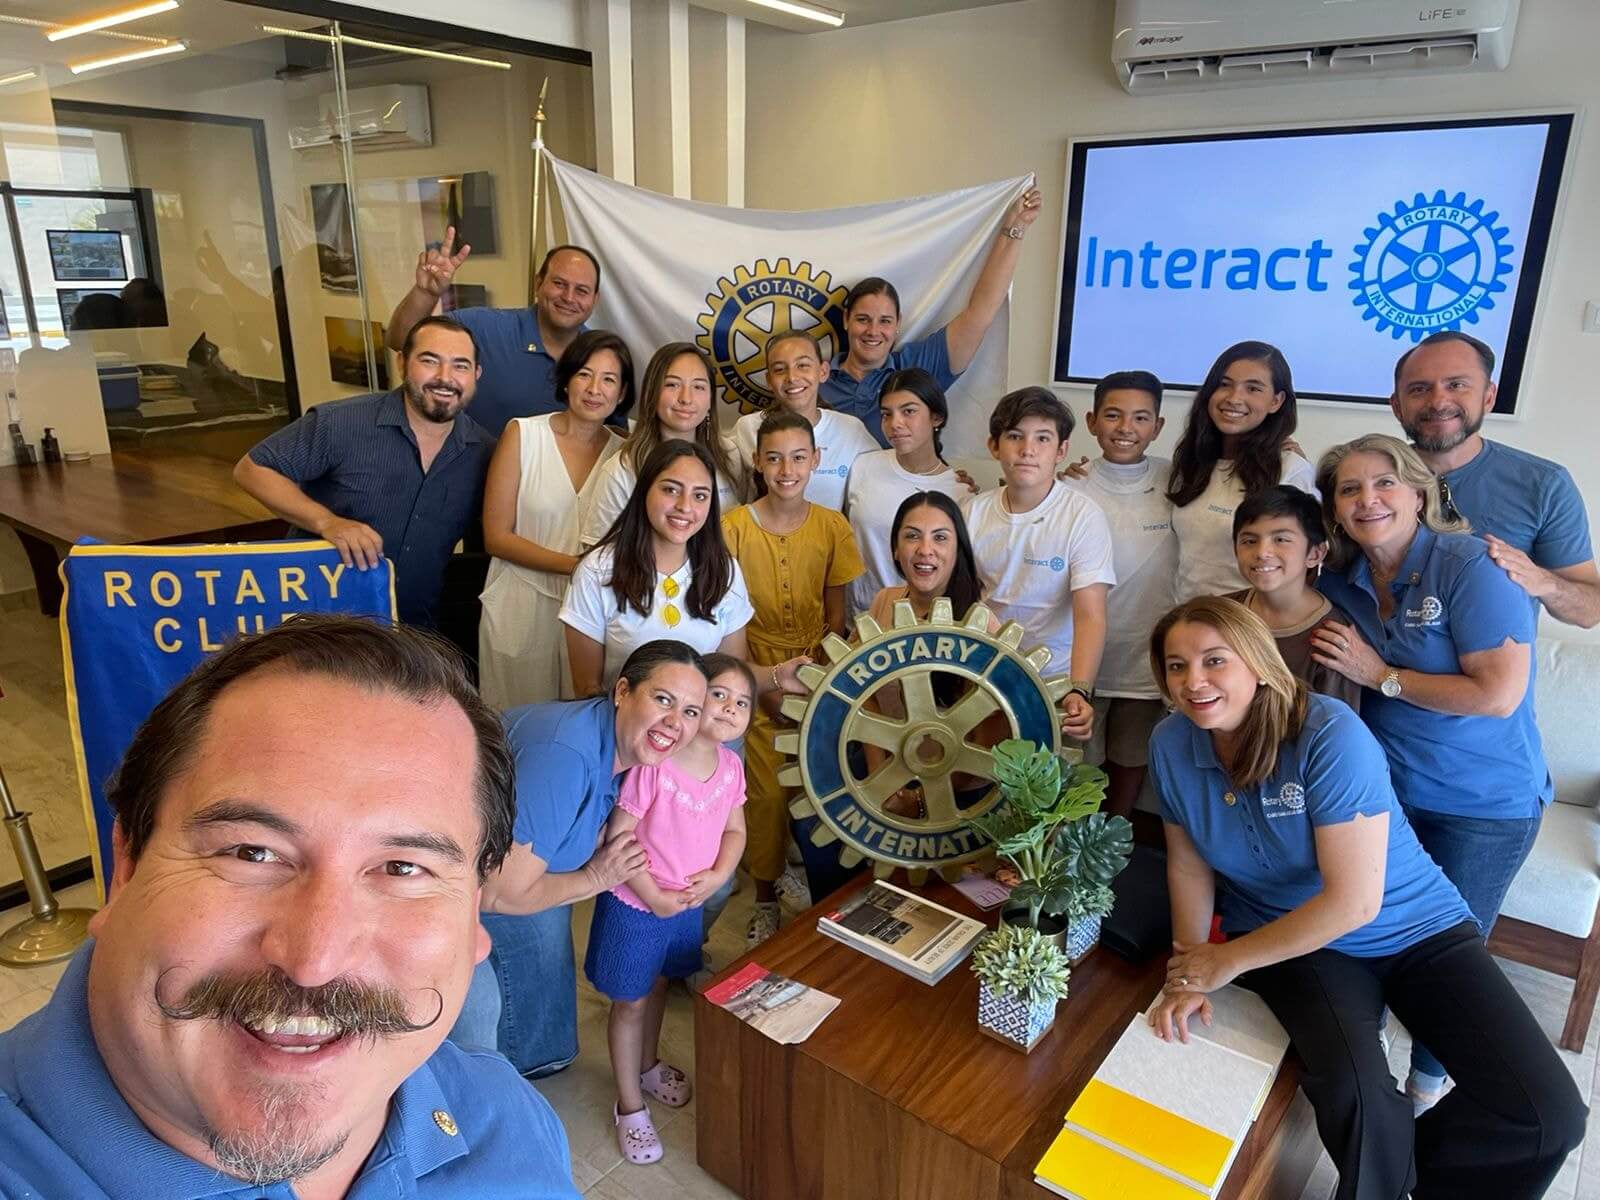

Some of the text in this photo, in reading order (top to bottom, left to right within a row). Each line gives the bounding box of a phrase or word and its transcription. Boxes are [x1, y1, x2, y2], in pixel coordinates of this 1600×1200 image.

[1403, 207, 1472, 226] ROTARY
[1085, 236, 1333, 292] Interact
[746, 280, 818, 302] ROTARY
[1369, 290, 1482, 327] INTERNATIONAL
[103, 563, 345, 608] ROTARY
[153, 612, 306, 653] CLU
[846, 636, 980, 687] ROTARY
